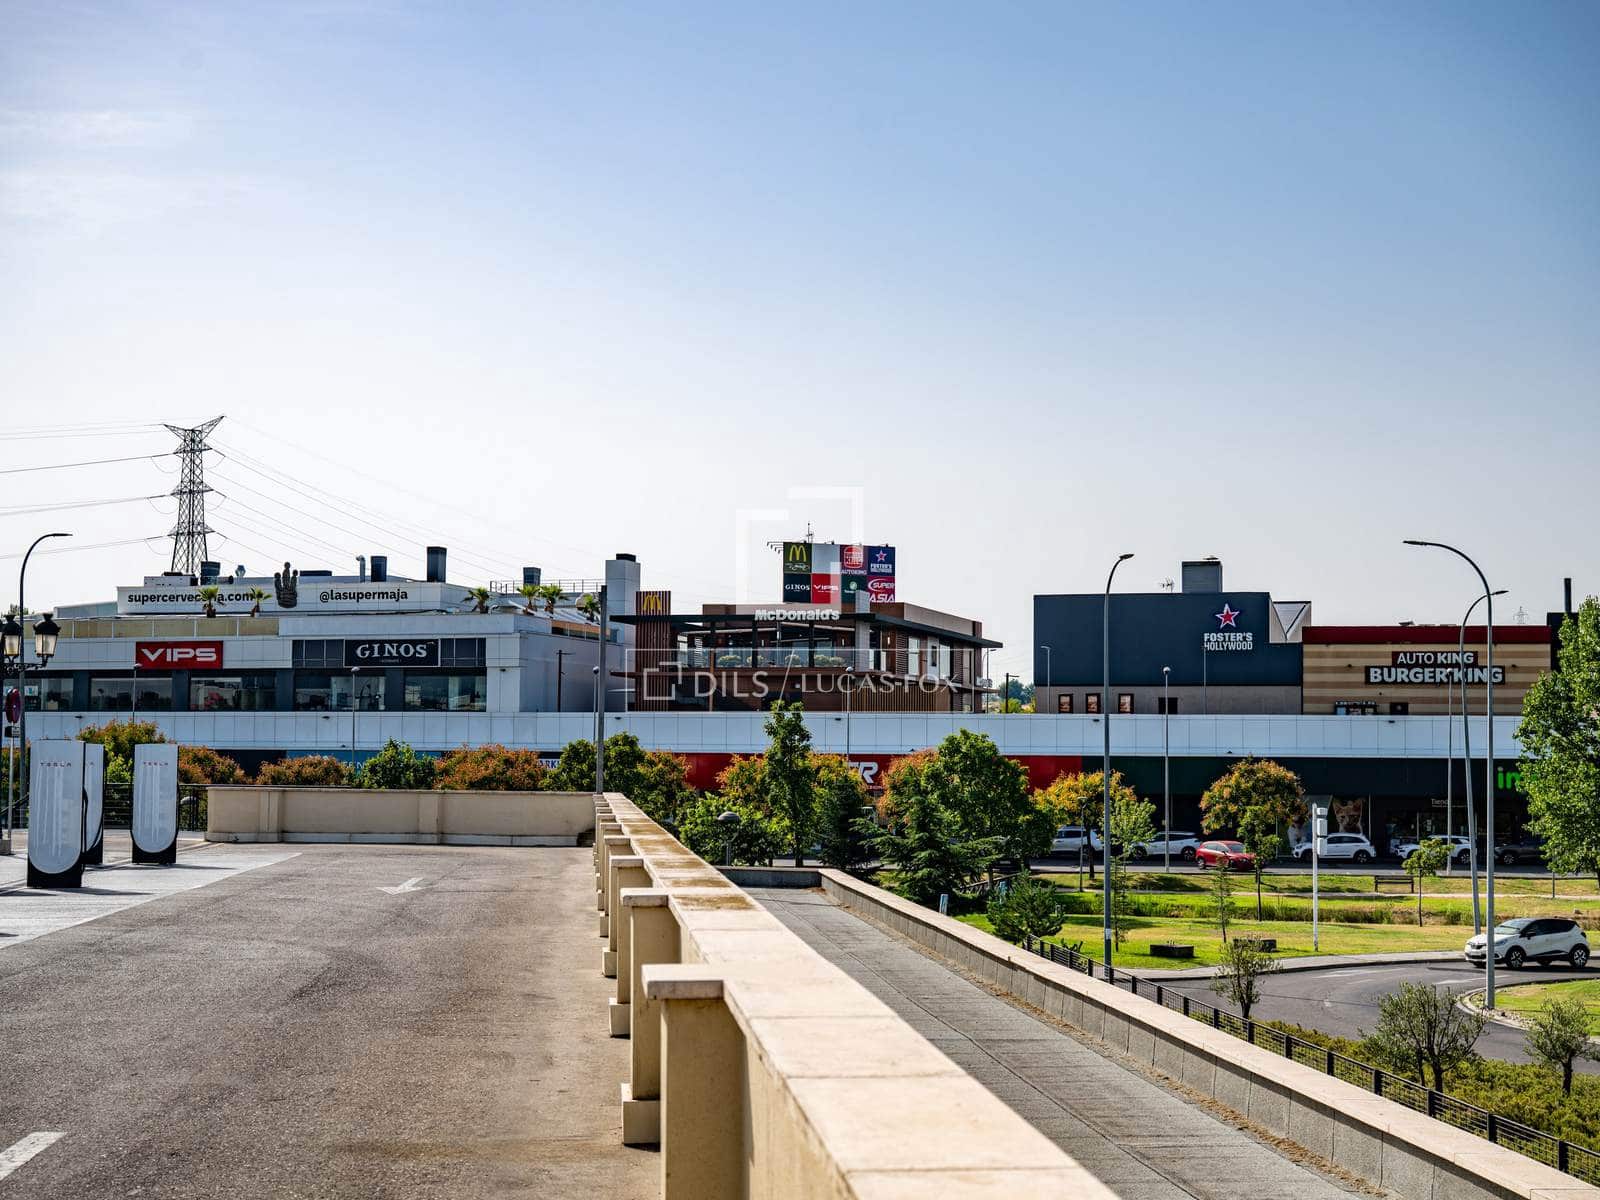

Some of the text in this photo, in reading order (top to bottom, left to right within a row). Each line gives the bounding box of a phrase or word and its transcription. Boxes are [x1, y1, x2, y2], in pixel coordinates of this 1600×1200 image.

[319, 588, 408, 604] @lasupermaja
[869, 594, 895, 603] ASIA
[754, 608, 840, 621] McDonald's
[1203, 632, 1253, 641] FOSTER'S
[356, 642, 427, 658] GINOS
[1203, 641, 1253, 651] HOLLYWOOD
[141, 647, 217, 662] VIPS
[1396, 652, 1475, 665] AUTO KING
[1369, 667, 1504, 683] BURGER KING
